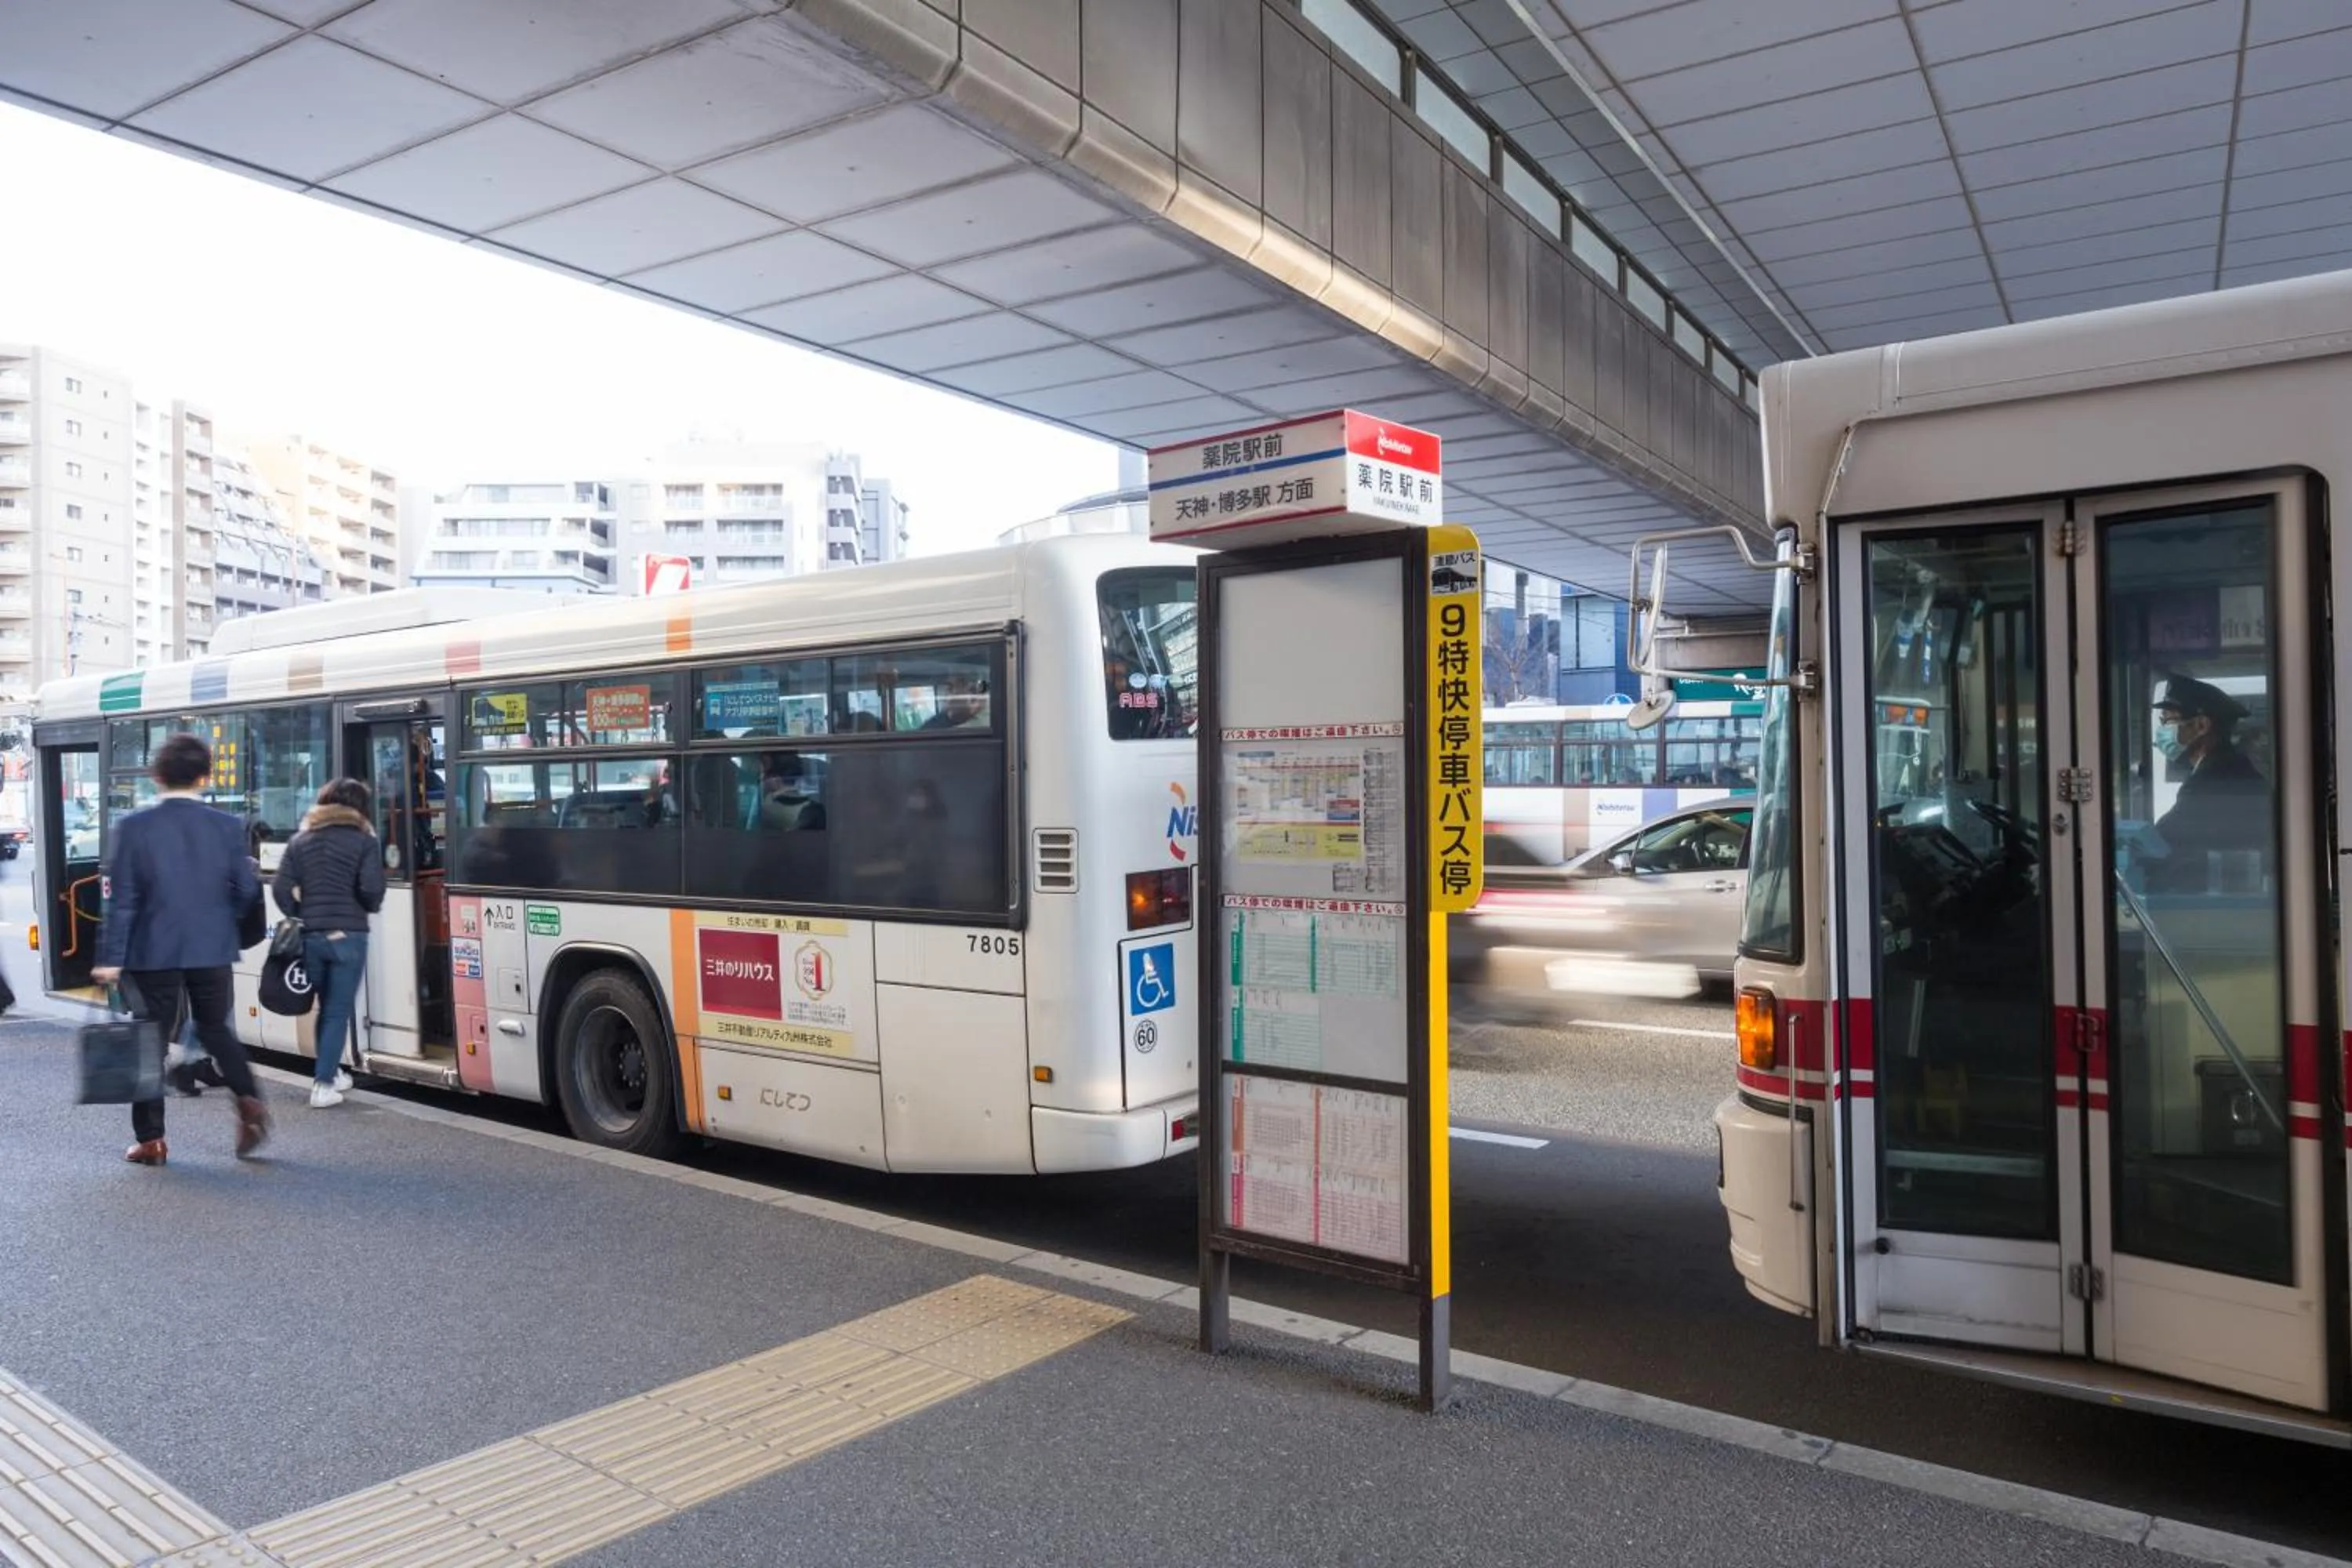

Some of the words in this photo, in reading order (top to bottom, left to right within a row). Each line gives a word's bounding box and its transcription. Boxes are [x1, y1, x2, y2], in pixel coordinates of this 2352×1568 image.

[1203, 433, 1283, 469] 薬院駅前
[1358, 463, 1433, 503] 薬院駅前
[1119, 692, 1158, 708] ABS
[1437, 603, 1472, 896] 9特快停車バス停
[495, 905, 514, 920] 入口
[967, 935, 1020, 956] 7805
[706, 958, 775, 982] 三井のリハウス
[1138, 1027, 1155, 1047] 60
[760, 1087, 811, 1112] にしてつ
